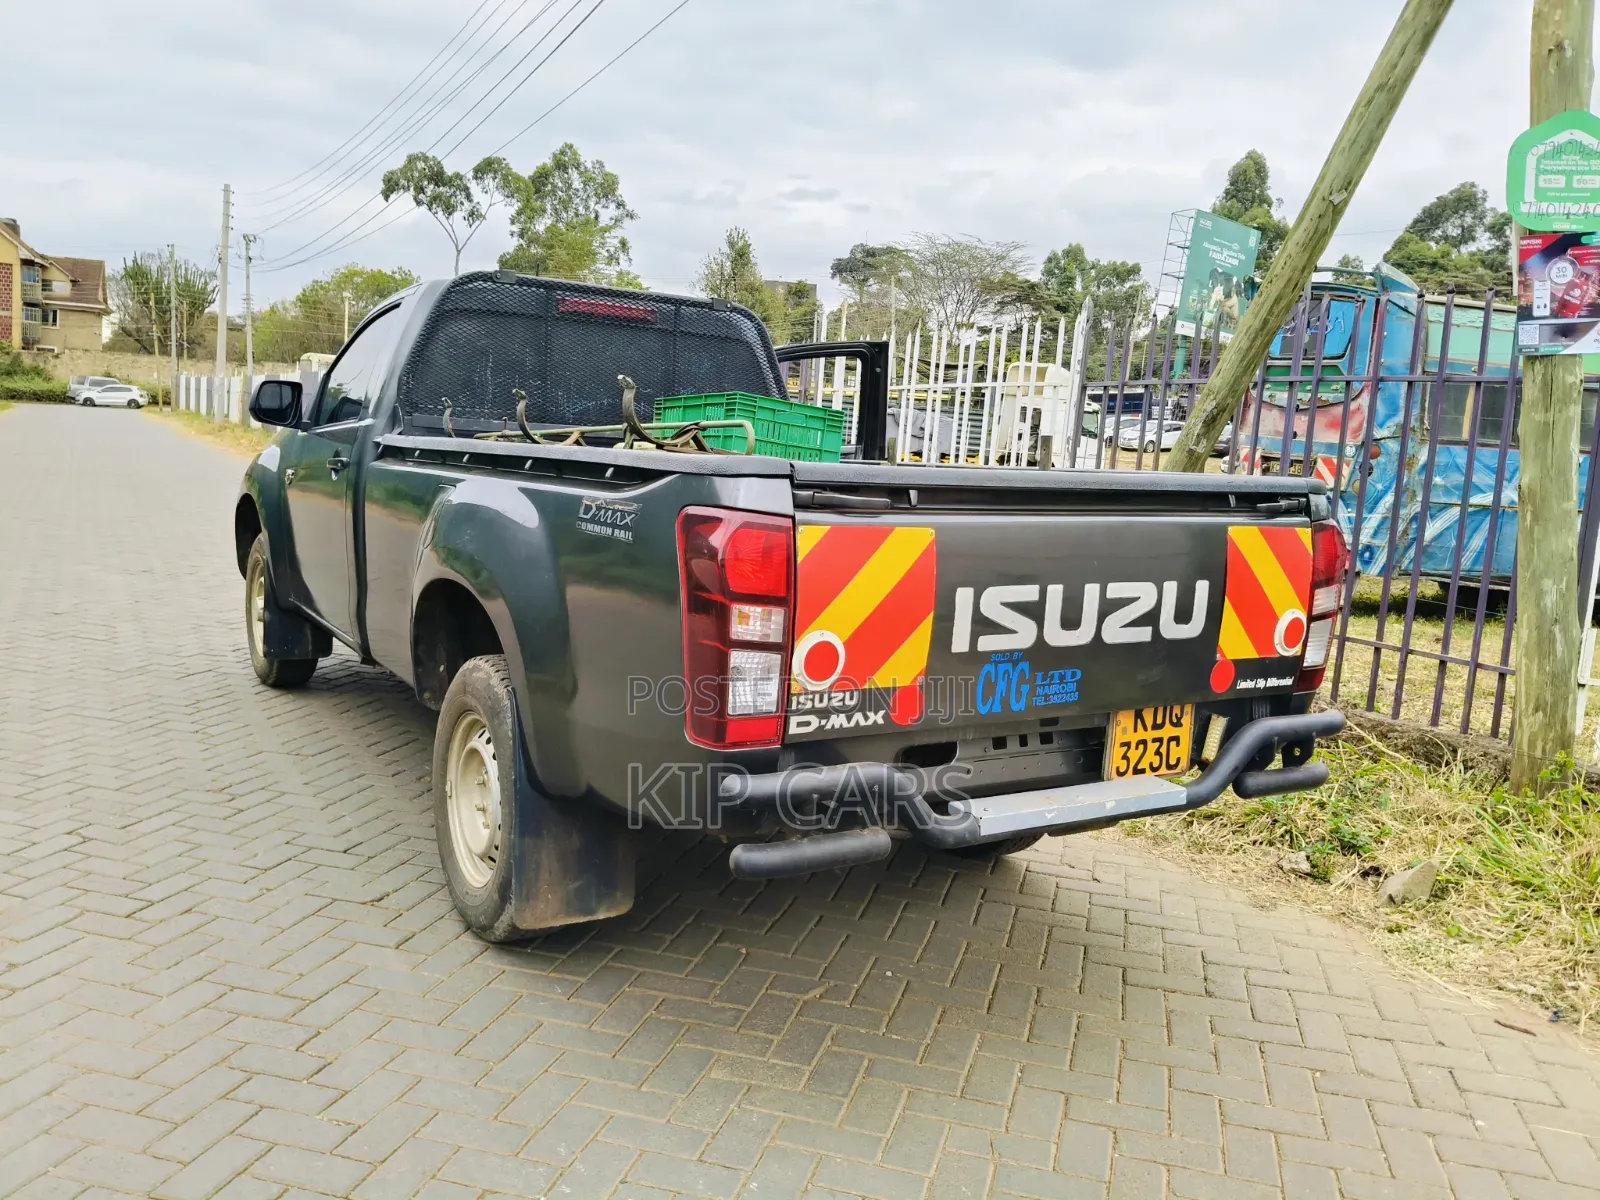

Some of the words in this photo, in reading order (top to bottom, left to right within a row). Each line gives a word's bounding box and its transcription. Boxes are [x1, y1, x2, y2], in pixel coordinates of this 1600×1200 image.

[1555, 266, 1567, 274] 30
[575, 520, 613, 537] COMMON
[613, 528, 634, 541] RAIL
[951, 580, 1210, 653] ISUZU
[990, 652, 1010, 661] SOLD
[1013, 651, 1024, 660] BY
[1034, 668, 1082, 685] LTD
[1236, 678, 1257, 689] Limited
[1255, 677, 1267, 689] Slip
[1265, 676, 1294, 687] Differential
[976, 661, 1030, 716] CFG
[1035, 682, 1077, 696] NAIROBI
[791, 691, 859, 710] ISUZU
[1133, 704, 1184, 734] KDQ
[1115, 735, 1182, 777] 323C
